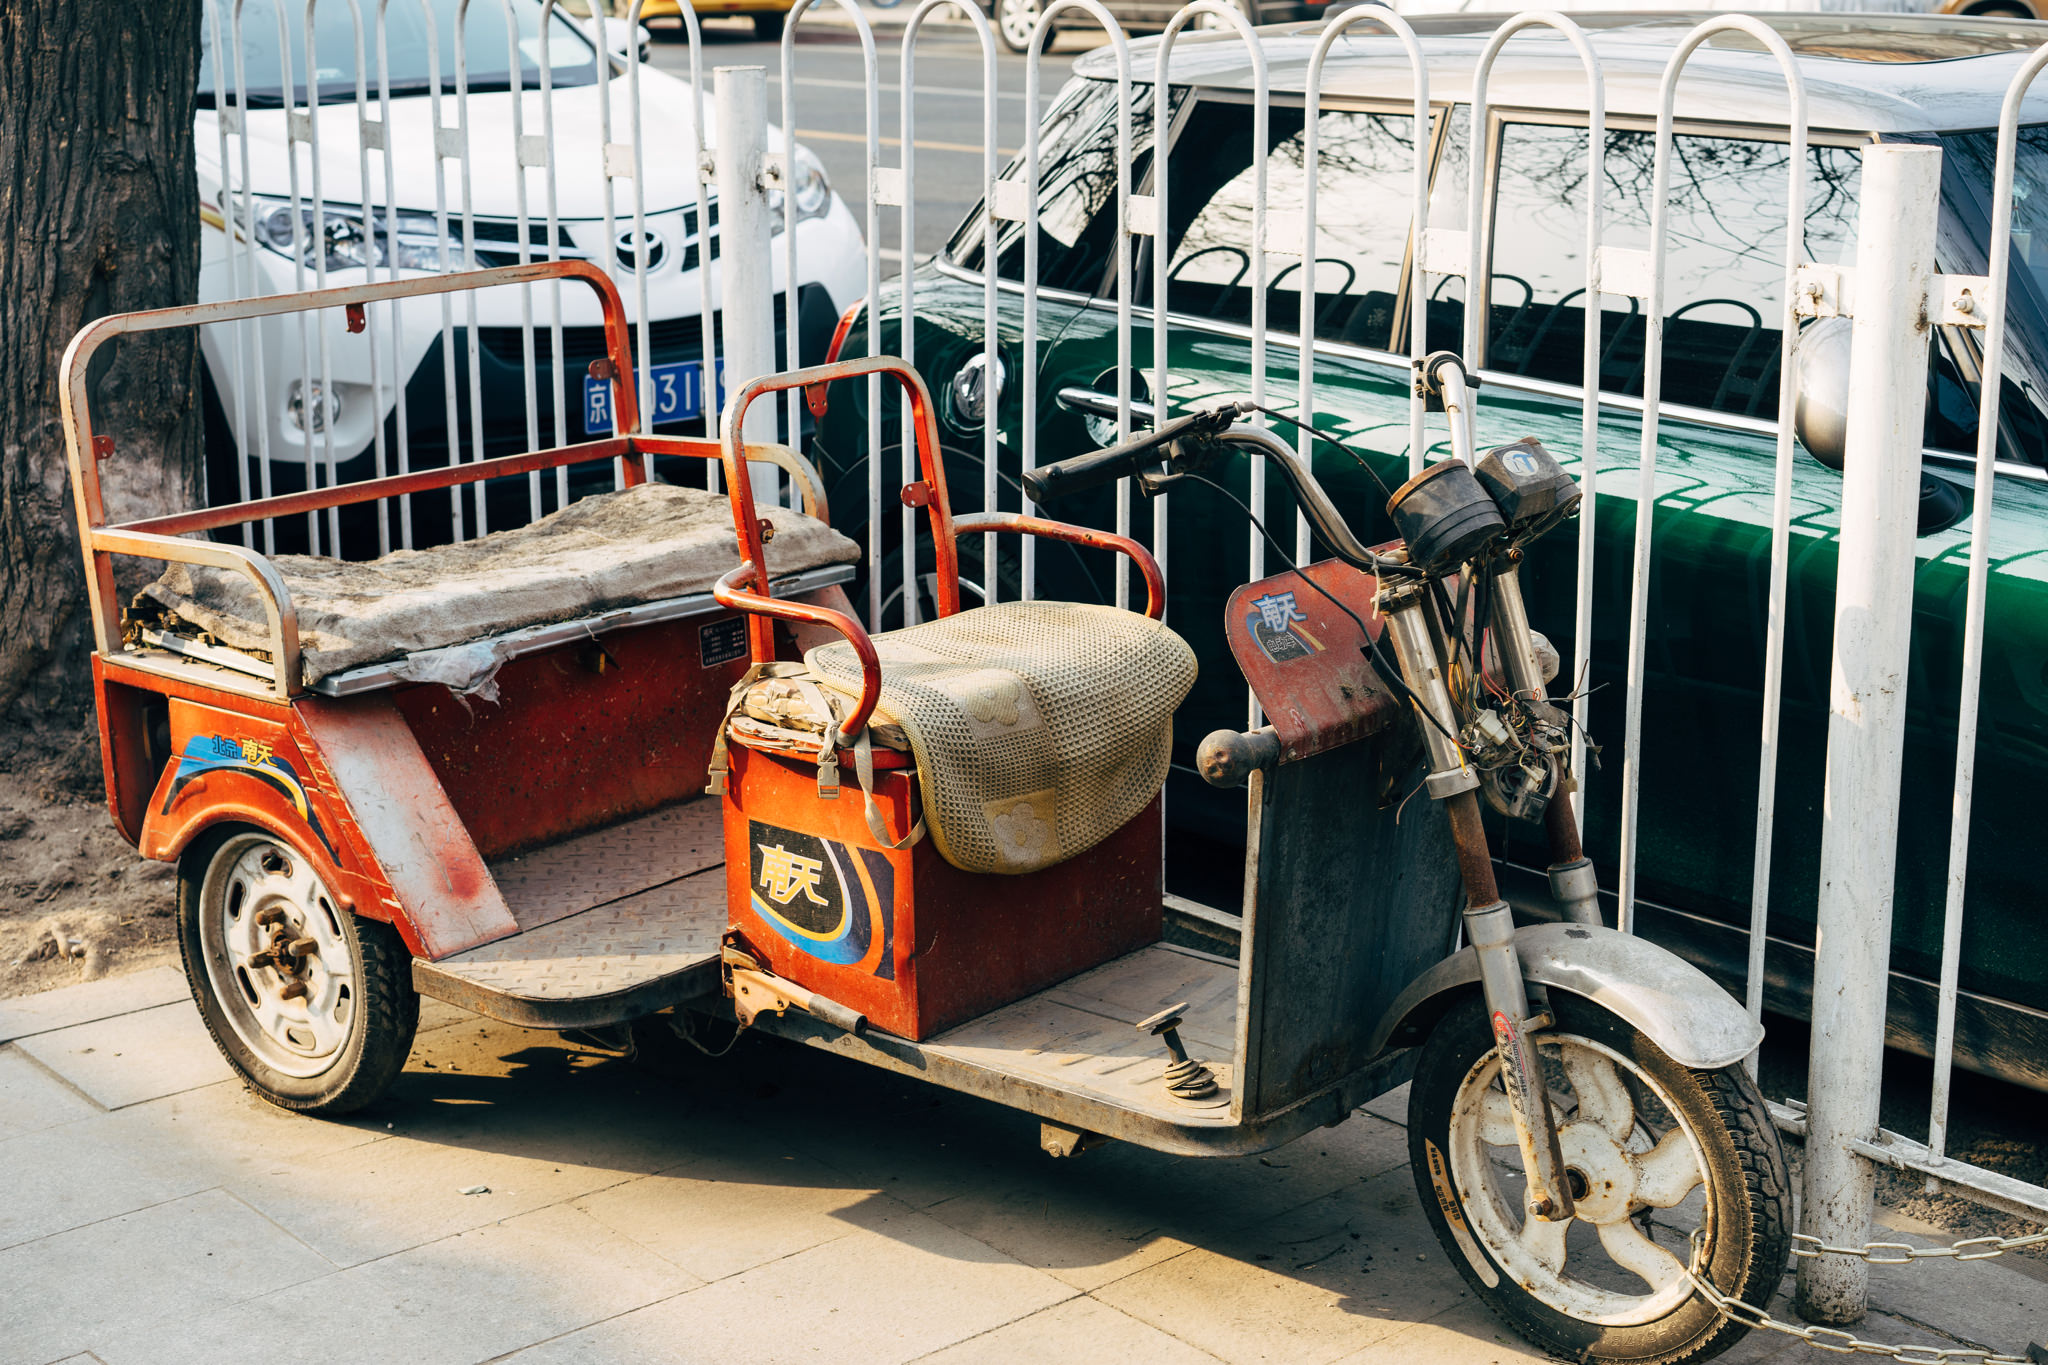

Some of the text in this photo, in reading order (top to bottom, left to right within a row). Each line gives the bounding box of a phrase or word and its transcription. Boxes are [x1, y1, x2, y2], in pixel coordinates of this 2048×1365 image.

[1250, 591, 1307, 632] 南天
[212, 734, 278, 767] 北京 南天
[757, 844, 828, 906] 南天
